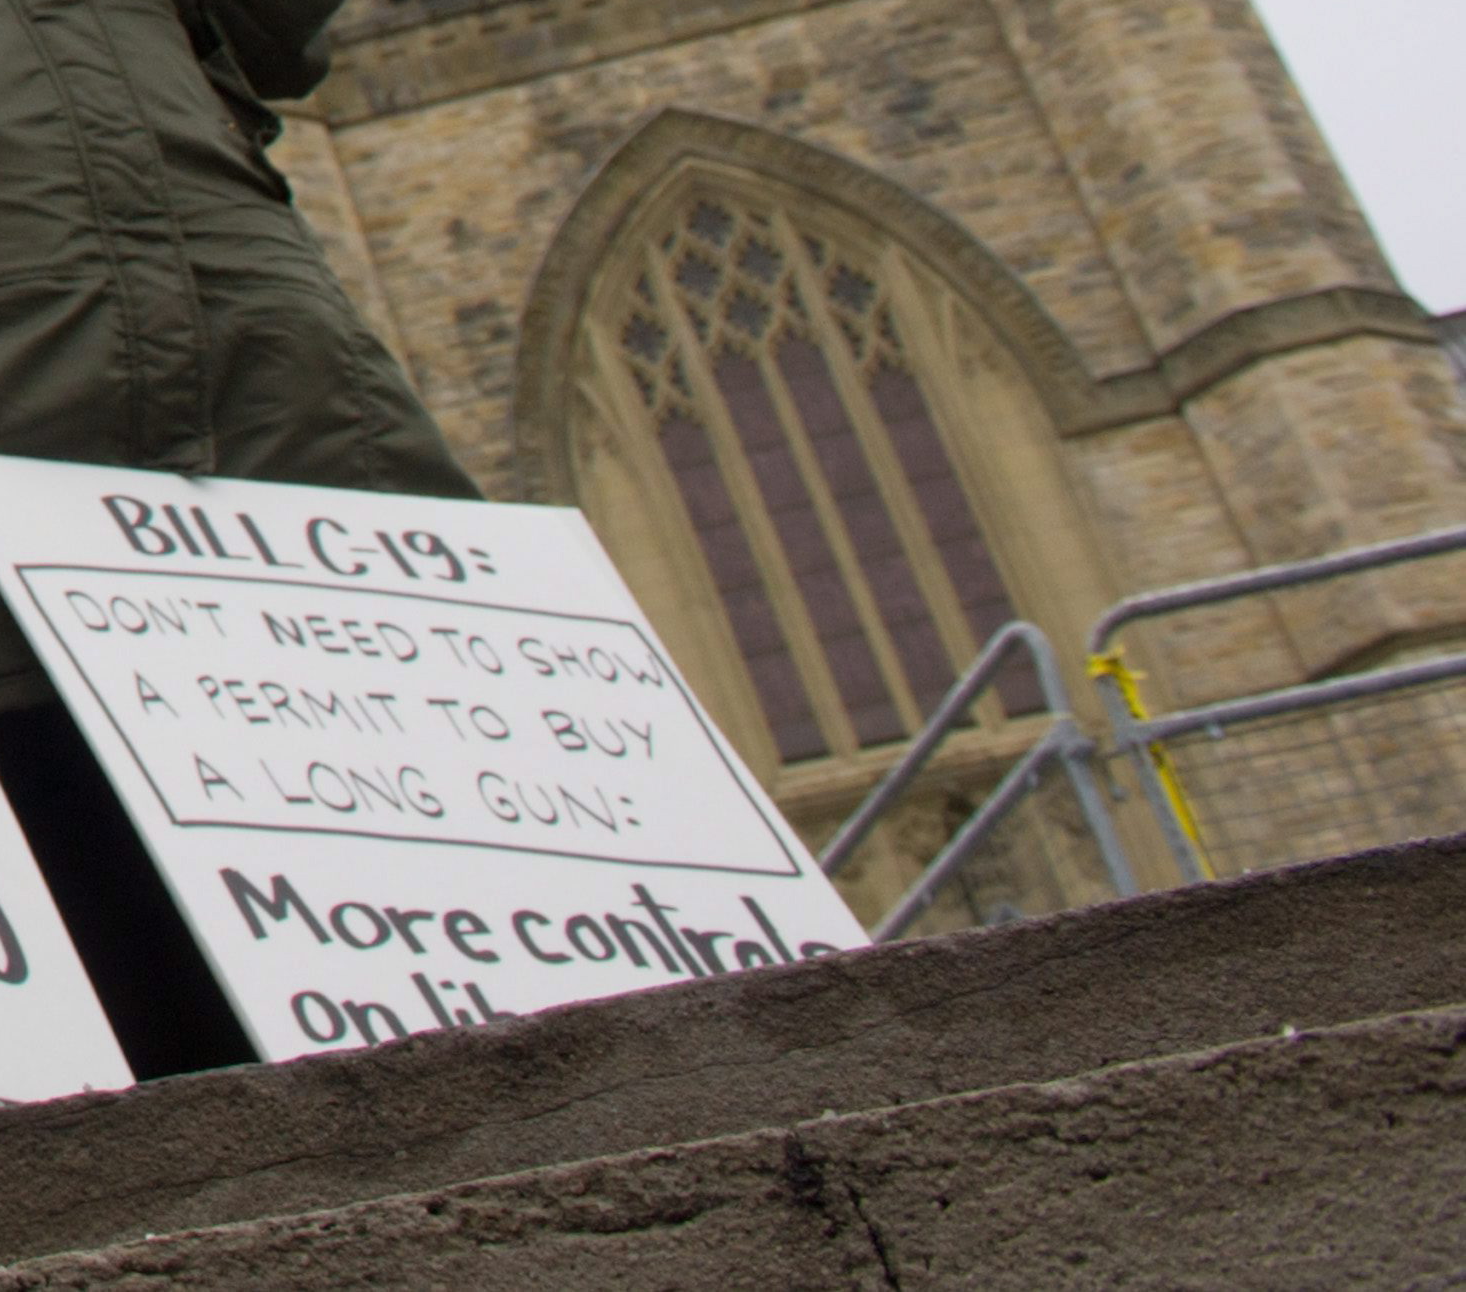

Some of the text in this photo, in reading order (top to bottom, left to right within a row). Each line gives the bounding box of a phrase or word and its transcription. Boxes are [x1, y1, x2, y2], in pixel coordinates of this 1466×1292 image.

[65, 590, 665, 688] DON'T NEED TO SHOW
[136, 673, 654, 760] A PERMIT TO BUY
[194, 753, 243, 802] A
[261, 758, 444, 818] LONG
[220, 867, 500, 962] More
